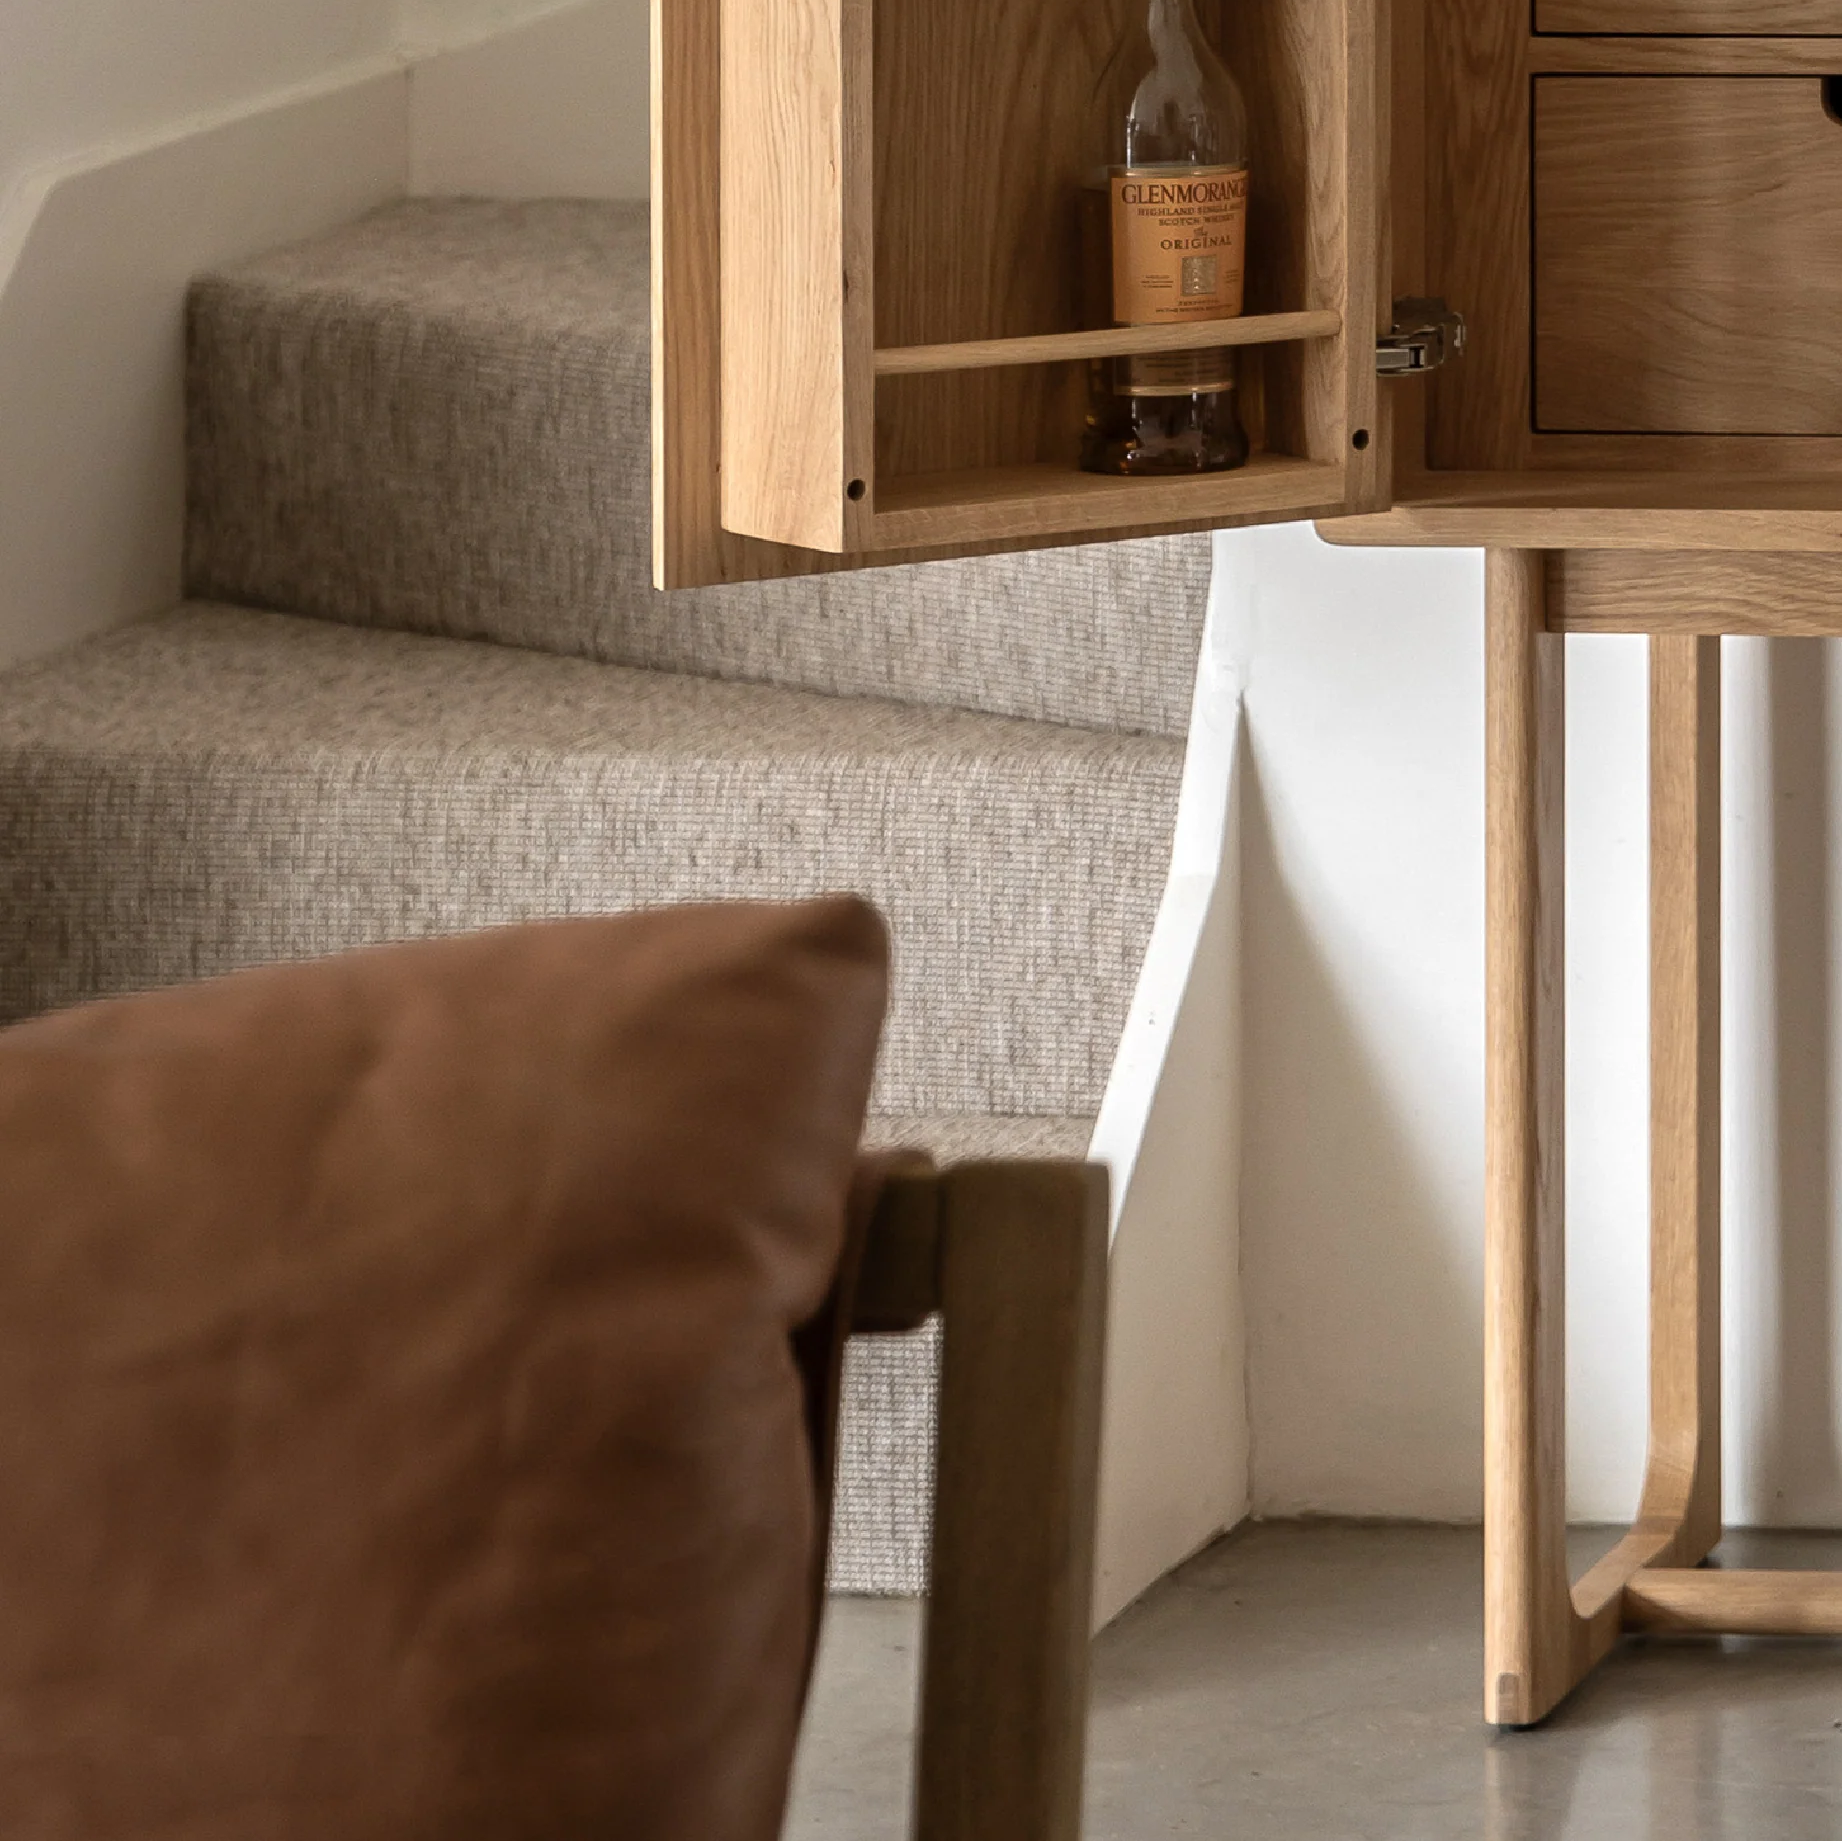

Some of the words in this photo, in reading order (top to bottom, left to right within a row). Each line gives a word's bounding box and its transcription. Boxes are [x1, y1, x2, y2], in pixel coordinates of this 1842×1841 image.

[1137, 207, 1195, 217] HIGHLAND
[1158, 216, 1200, 226] SCOTCH
[1160, 234, 1233, 250] ORIGINAL
